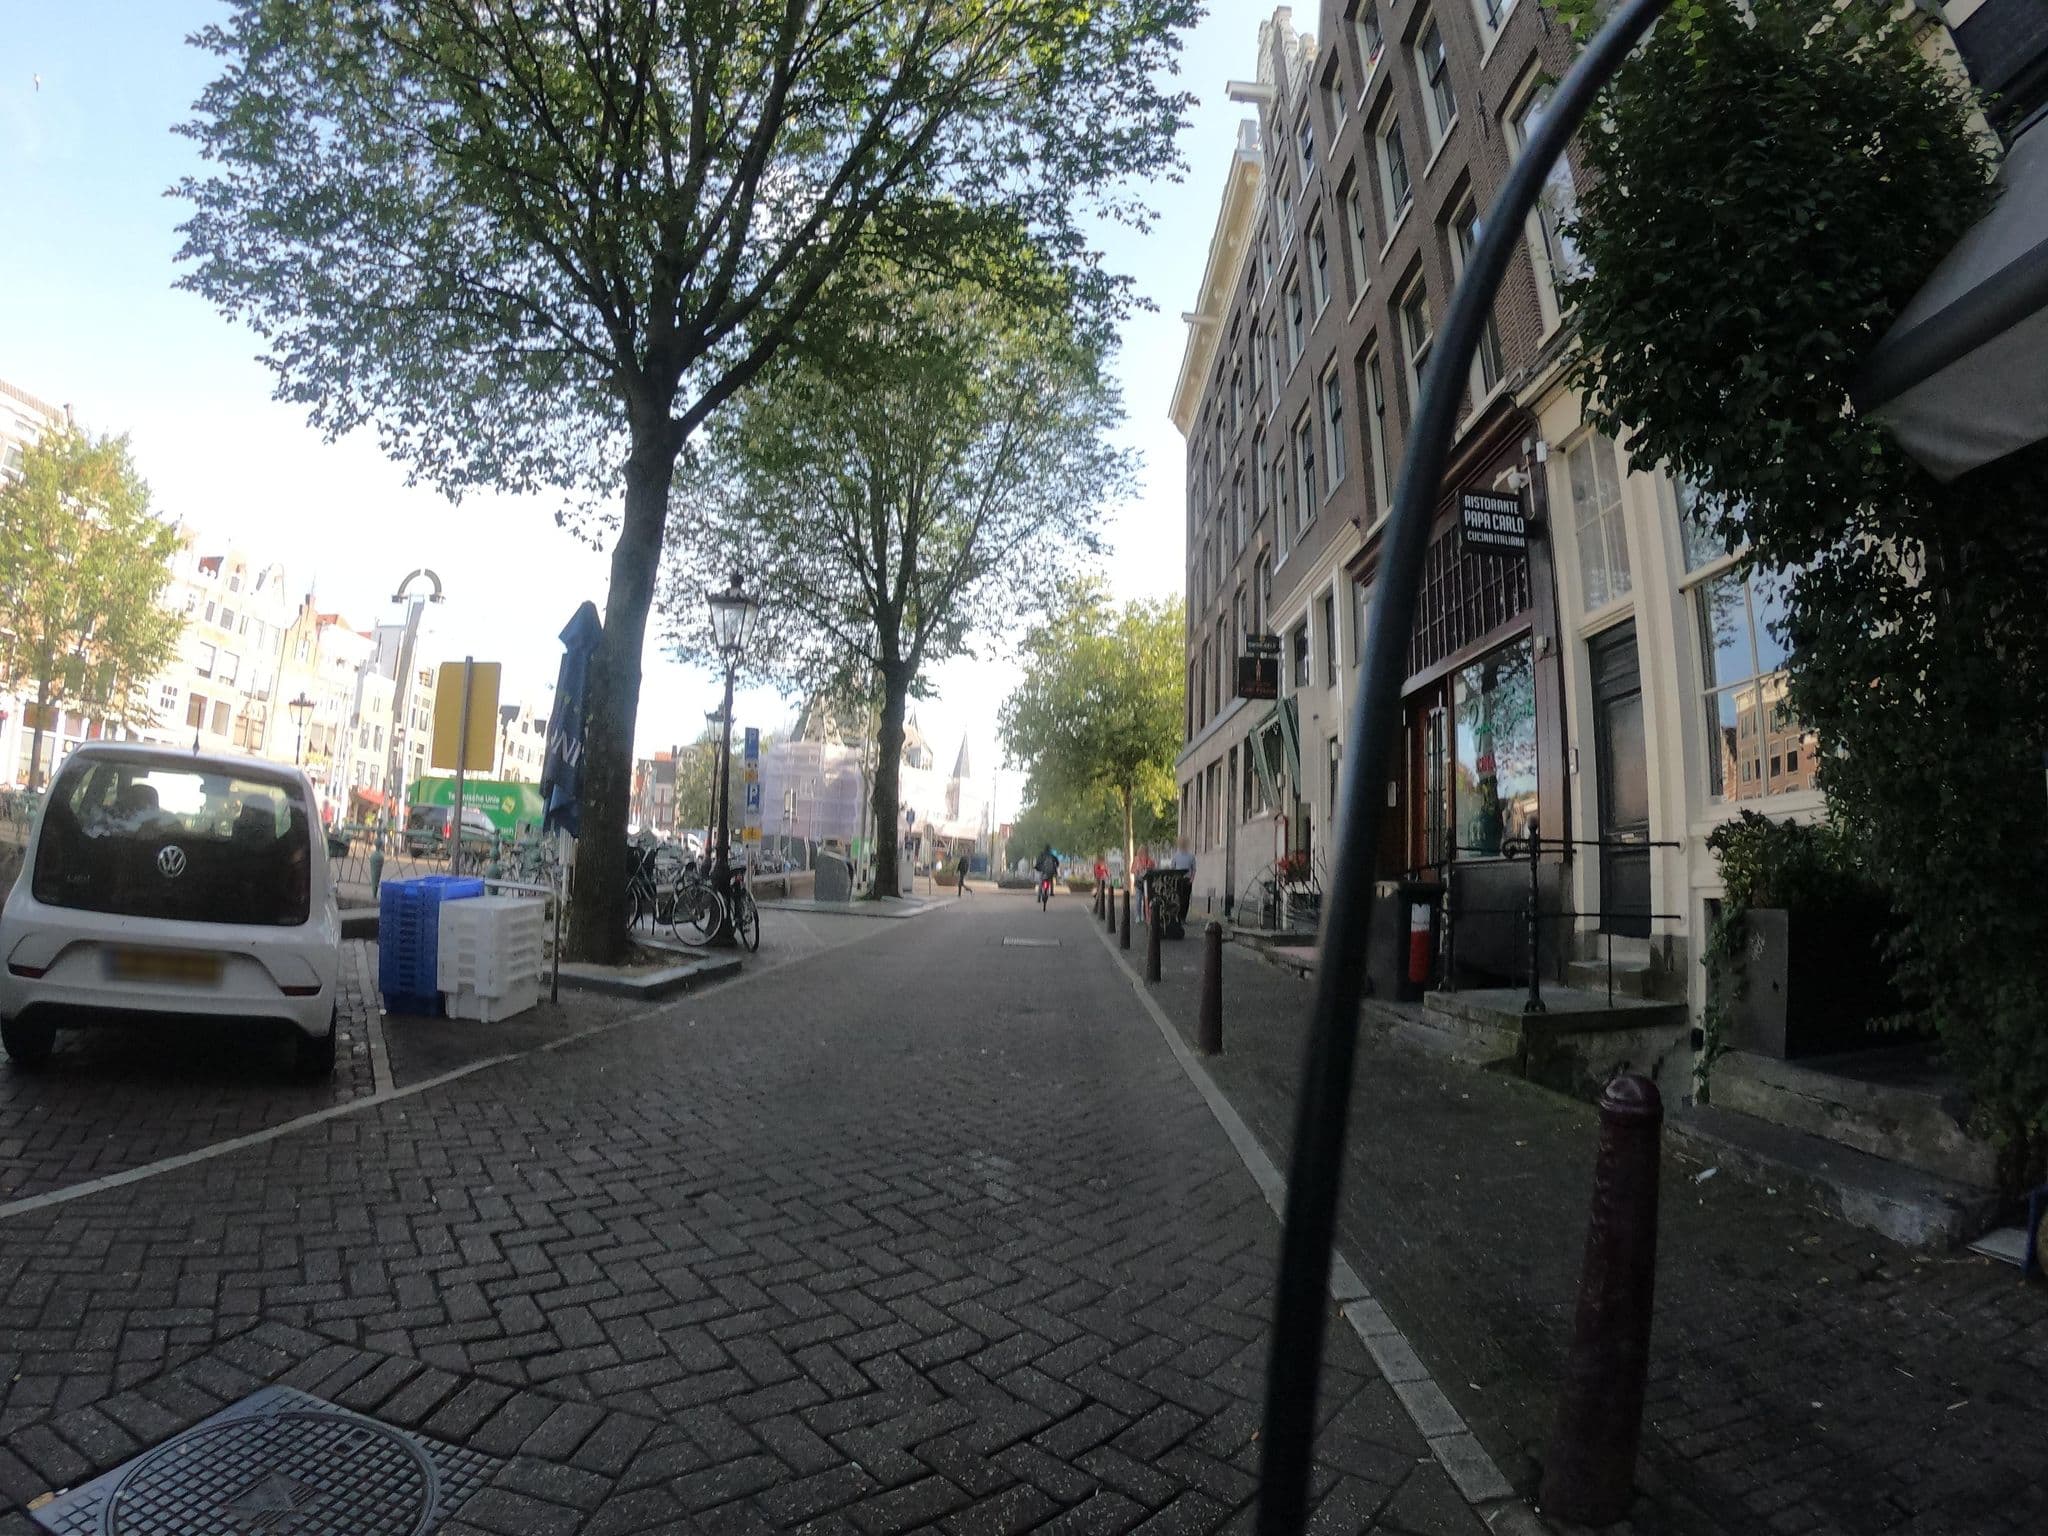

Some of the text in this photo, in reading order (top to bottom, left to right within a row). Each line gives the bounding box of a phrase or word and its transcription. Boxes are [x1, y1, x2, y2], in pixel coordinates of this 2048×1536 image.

[1464, 495, 1519, 514] RISTORANTE
[1464, 509, 1525, 533] PAPA CARLO
[1467, 530, 1525, 548] CUCINA ITALIANA
